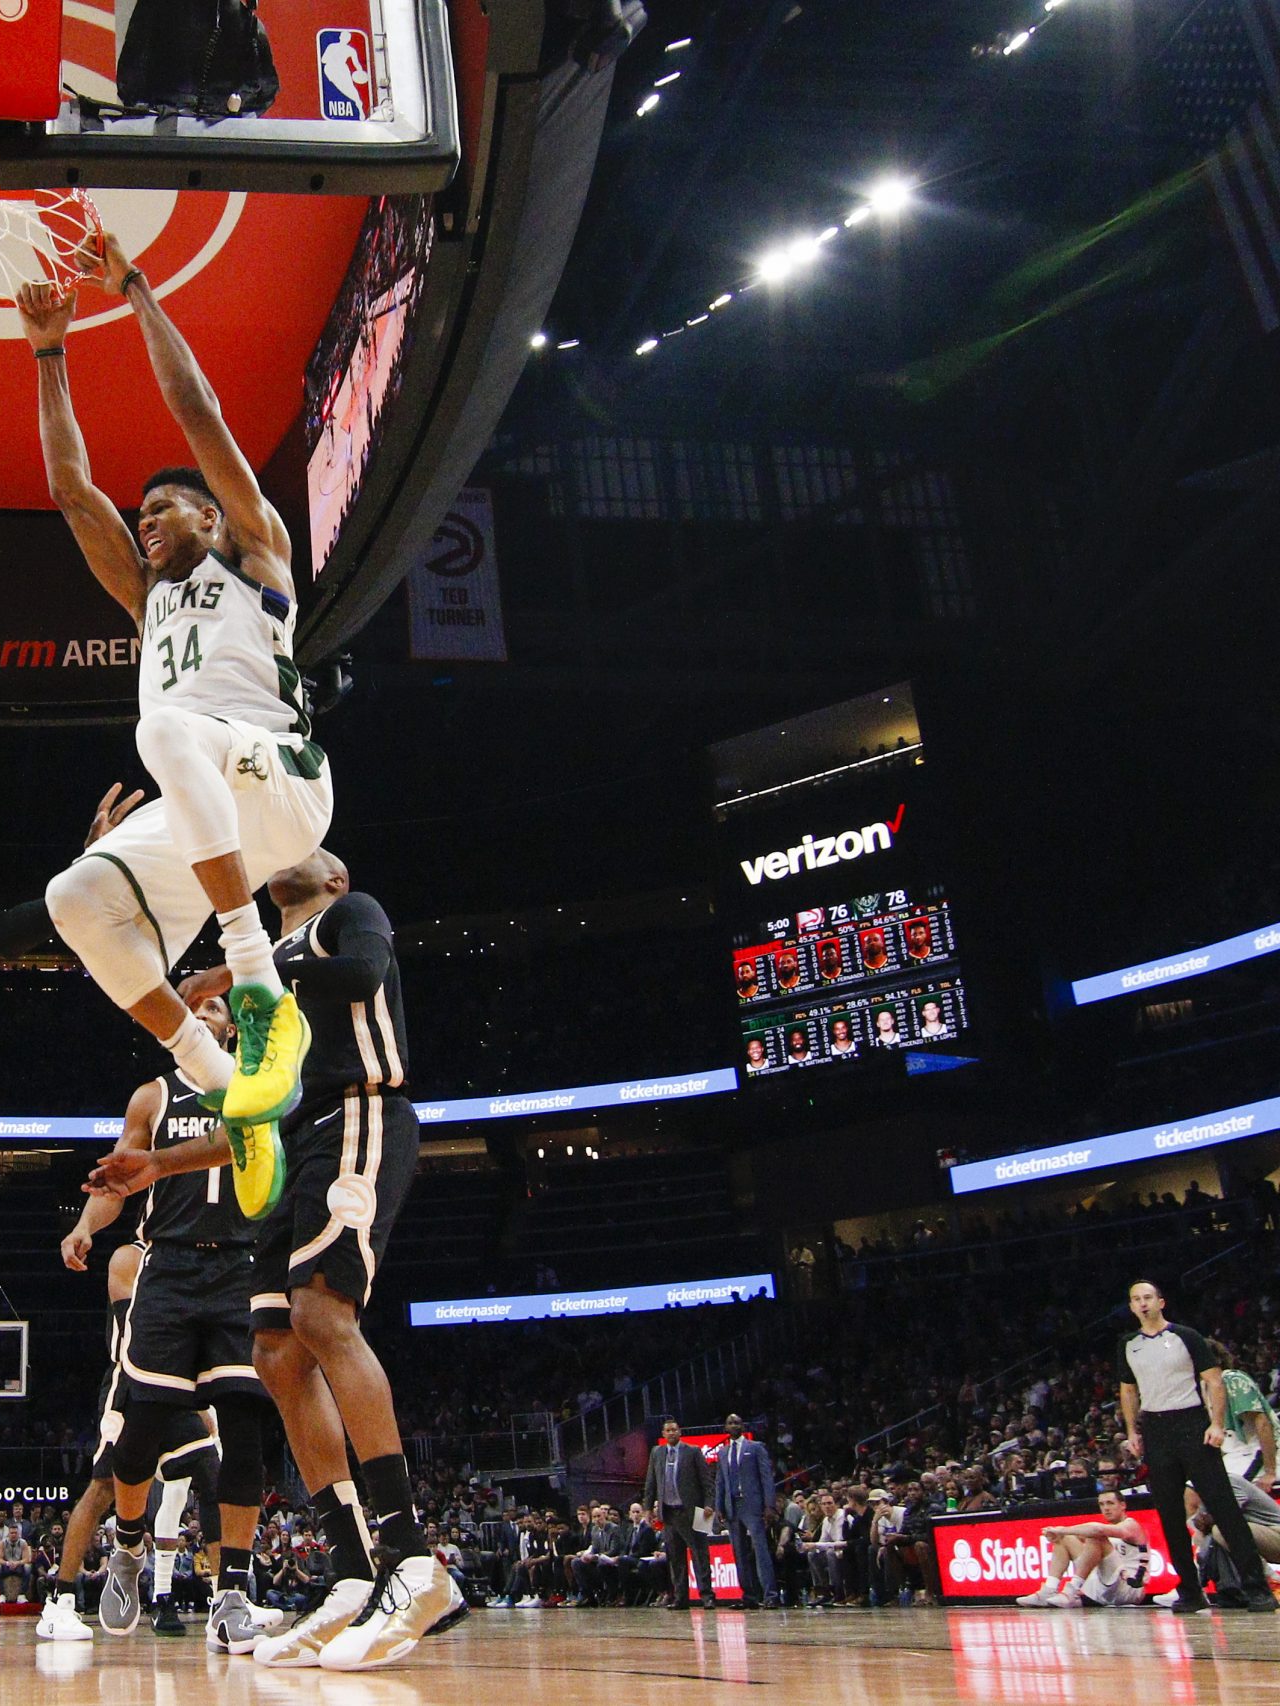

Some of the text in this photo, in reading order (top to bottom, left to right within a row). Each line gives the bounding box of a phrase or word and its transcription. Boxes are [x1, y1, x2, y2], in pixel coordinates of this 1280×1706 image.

[328, 101, 354, 116] NBA
[426, 608, 486, 626] TURNER
[62, 638, 142, 666] AREN
[157, 624, 203, 692] 34
[741, 821, 890, 885] verizon
[885, 890, 906, 906] 78
[828, 904, 848, 920] 76
[767, 918, 790, 932] 5:00
[838, 925, 855, 935] 50%
[873, 916, 896, 926] 84.6%
[1121, 955, 1210, 988] ticketmaster
[809, 1007, 831, 1016] 49.1%
[846, 999, 869, 1009] 28.6%
[884, 990, 908, 1001] 94.1%
[619, 1078, 709, 1100] ticketmaster
[489, 1094, 575, 1114] ticketmaster
[1153, 1114, 1255, 1150] ticketmaster
[995, 1149, 1092, 1180] ticketmaster
[666, 1284, 746, 1303] ticketmaster
[435, 1303, 512, 1319] ticketmaster
[551, 1295, 628, 1312] ticketmaster
